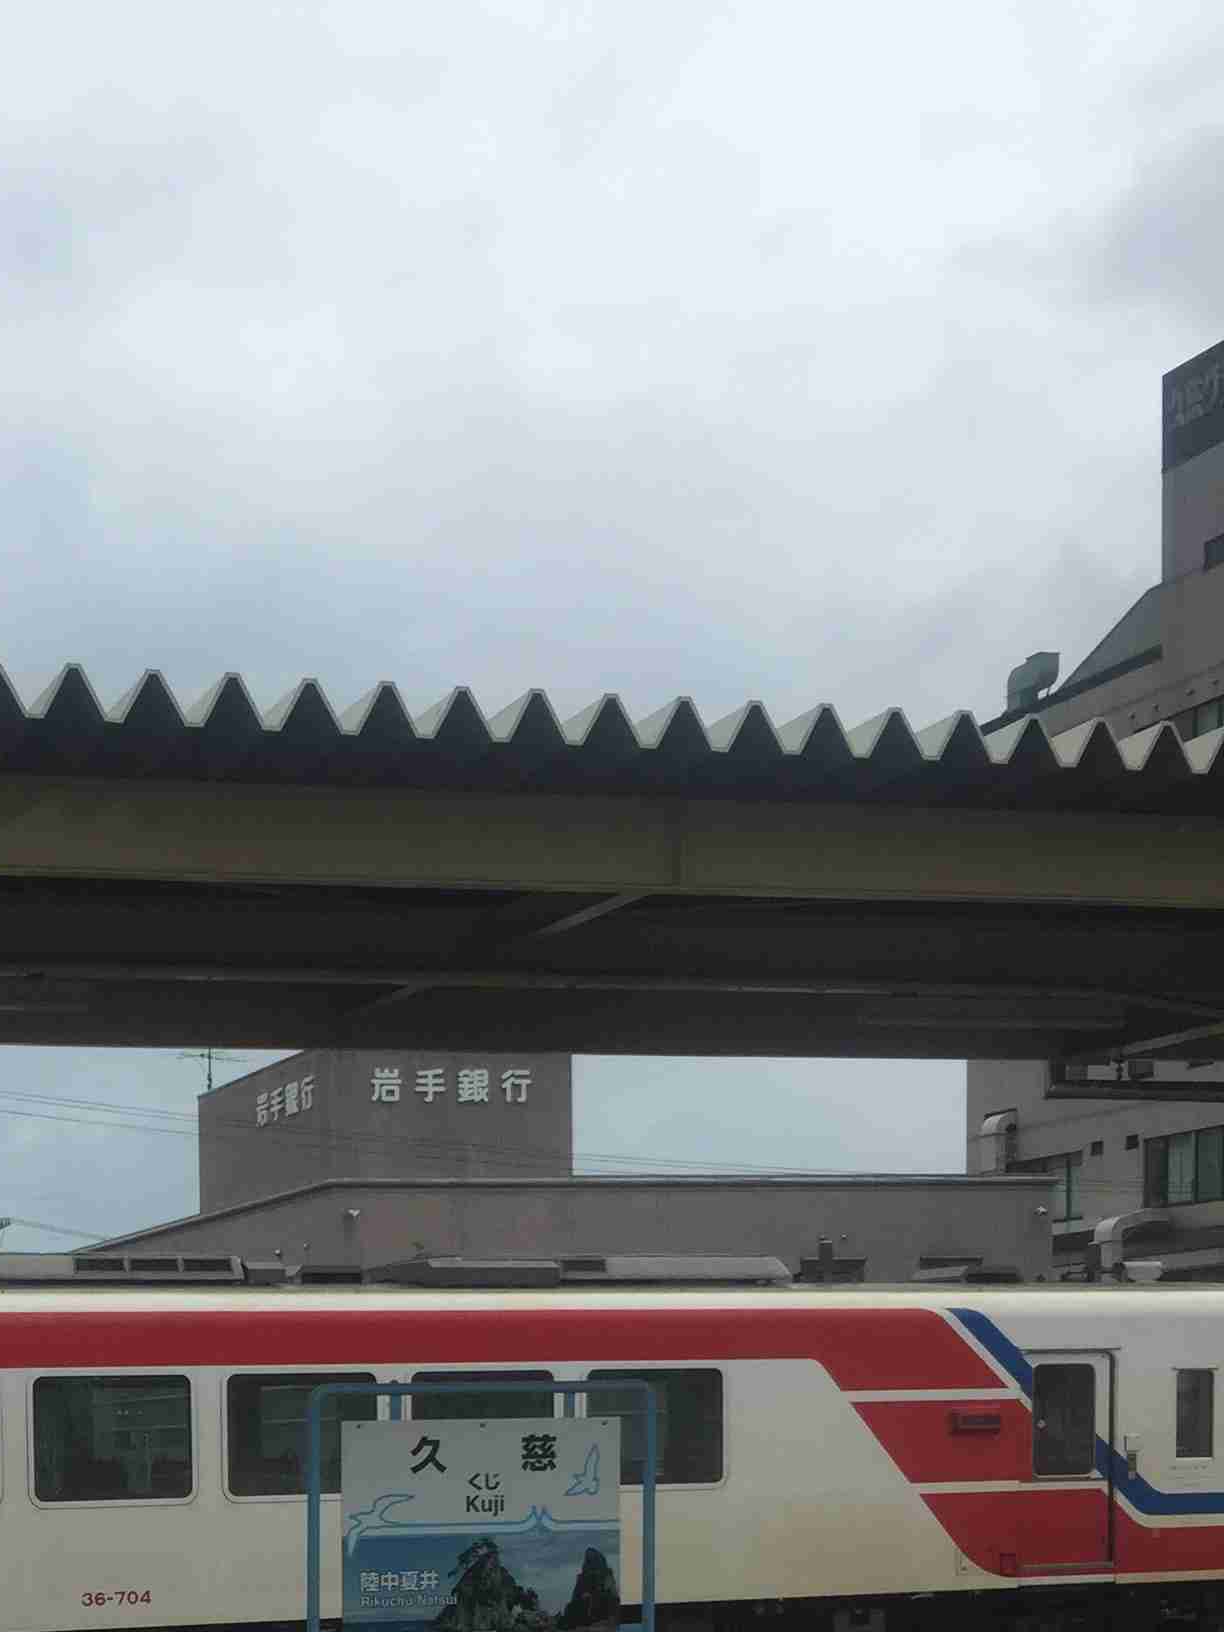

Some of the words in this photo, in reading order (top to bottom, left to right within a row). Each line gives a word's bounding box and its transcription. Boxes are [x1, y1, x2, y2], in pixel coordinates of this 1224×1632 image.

[370, 1068, 532, 1103] 岩手銀行
[255, 1075, 314, 1128] 岩手銀行
[410, 1434, 557, 1474] 久慈
[468, 1473, 500, 1490] くじ
[466, 1495, 505, 1516] Kuji
[81, 1590, 152, 1607] 36-704
